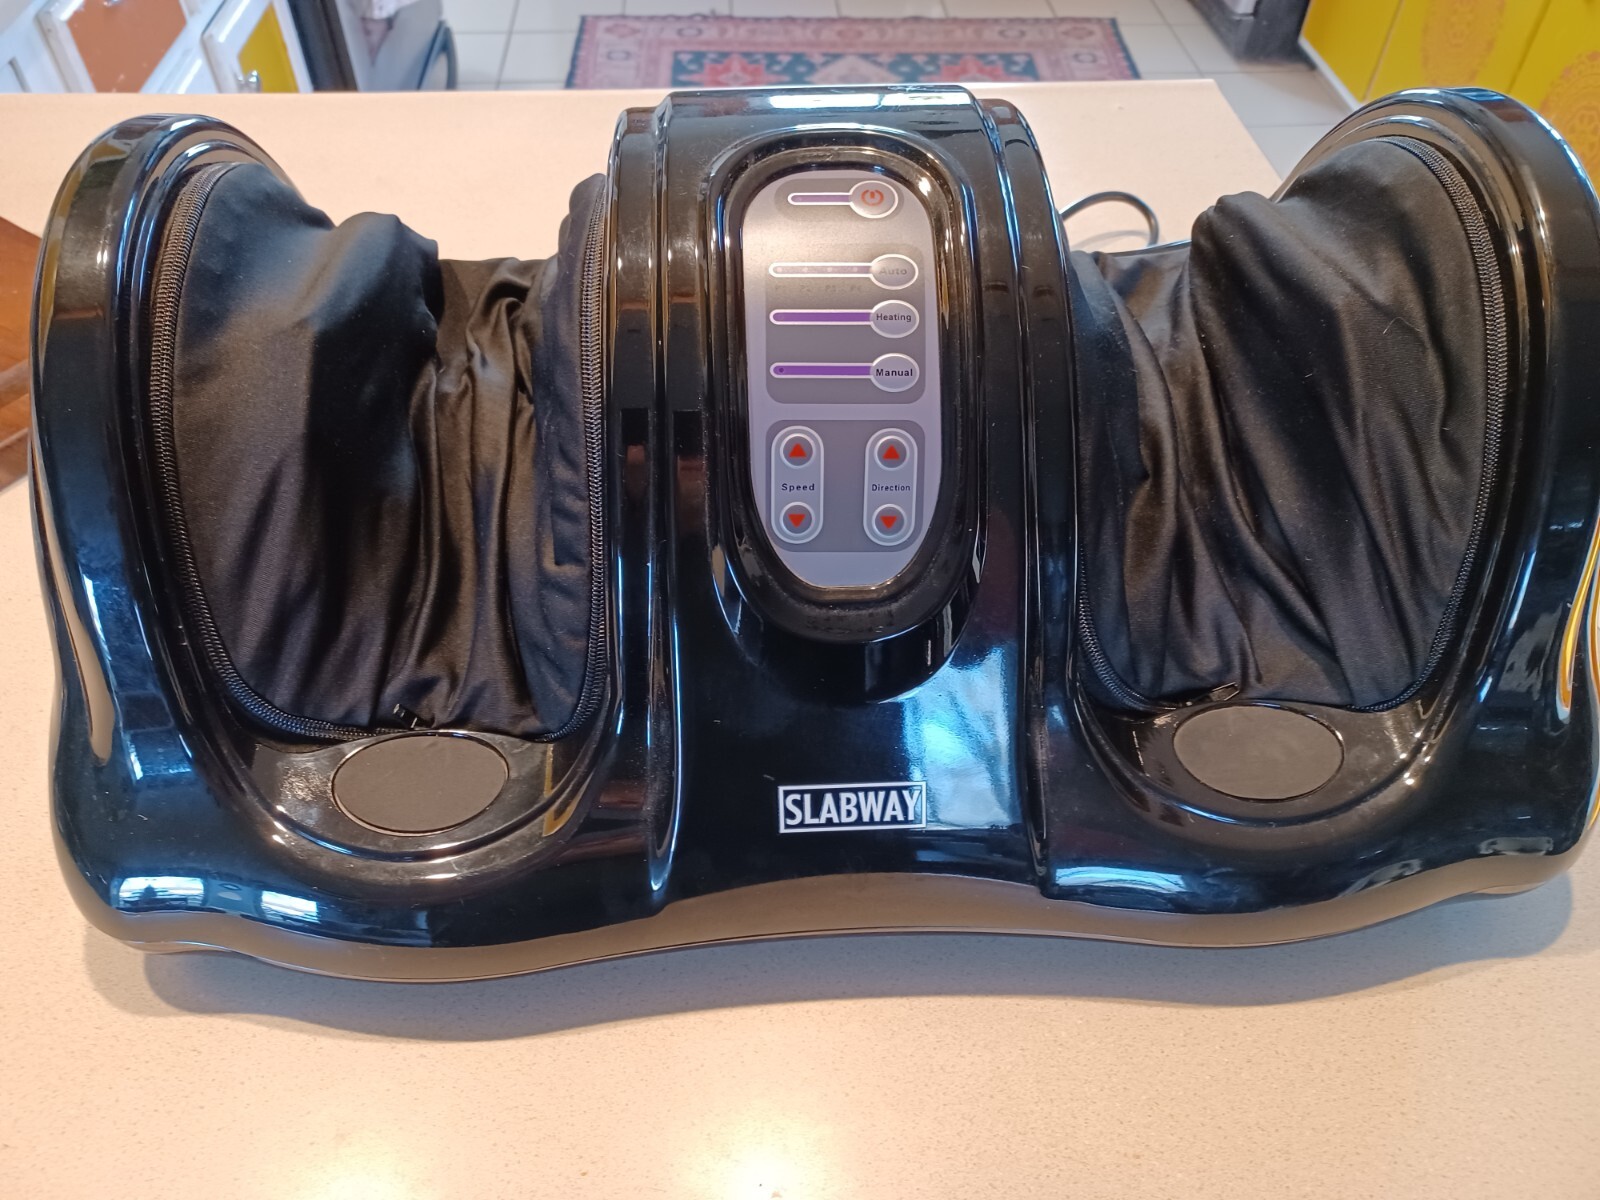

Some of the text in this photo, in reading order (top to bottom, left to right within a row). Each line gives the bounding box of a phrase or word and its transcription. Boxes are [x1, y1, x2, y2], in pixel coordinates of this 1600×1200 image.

[879, 266, 908, 276] Auto
[876, 312, 912, 323] Heating
[876, 368, 913, 377] Manual
[781, 483, 815, 493] Speed
[871, 484, 911, 492] Direction
[785, 789, 921, 826] SLABWAY
